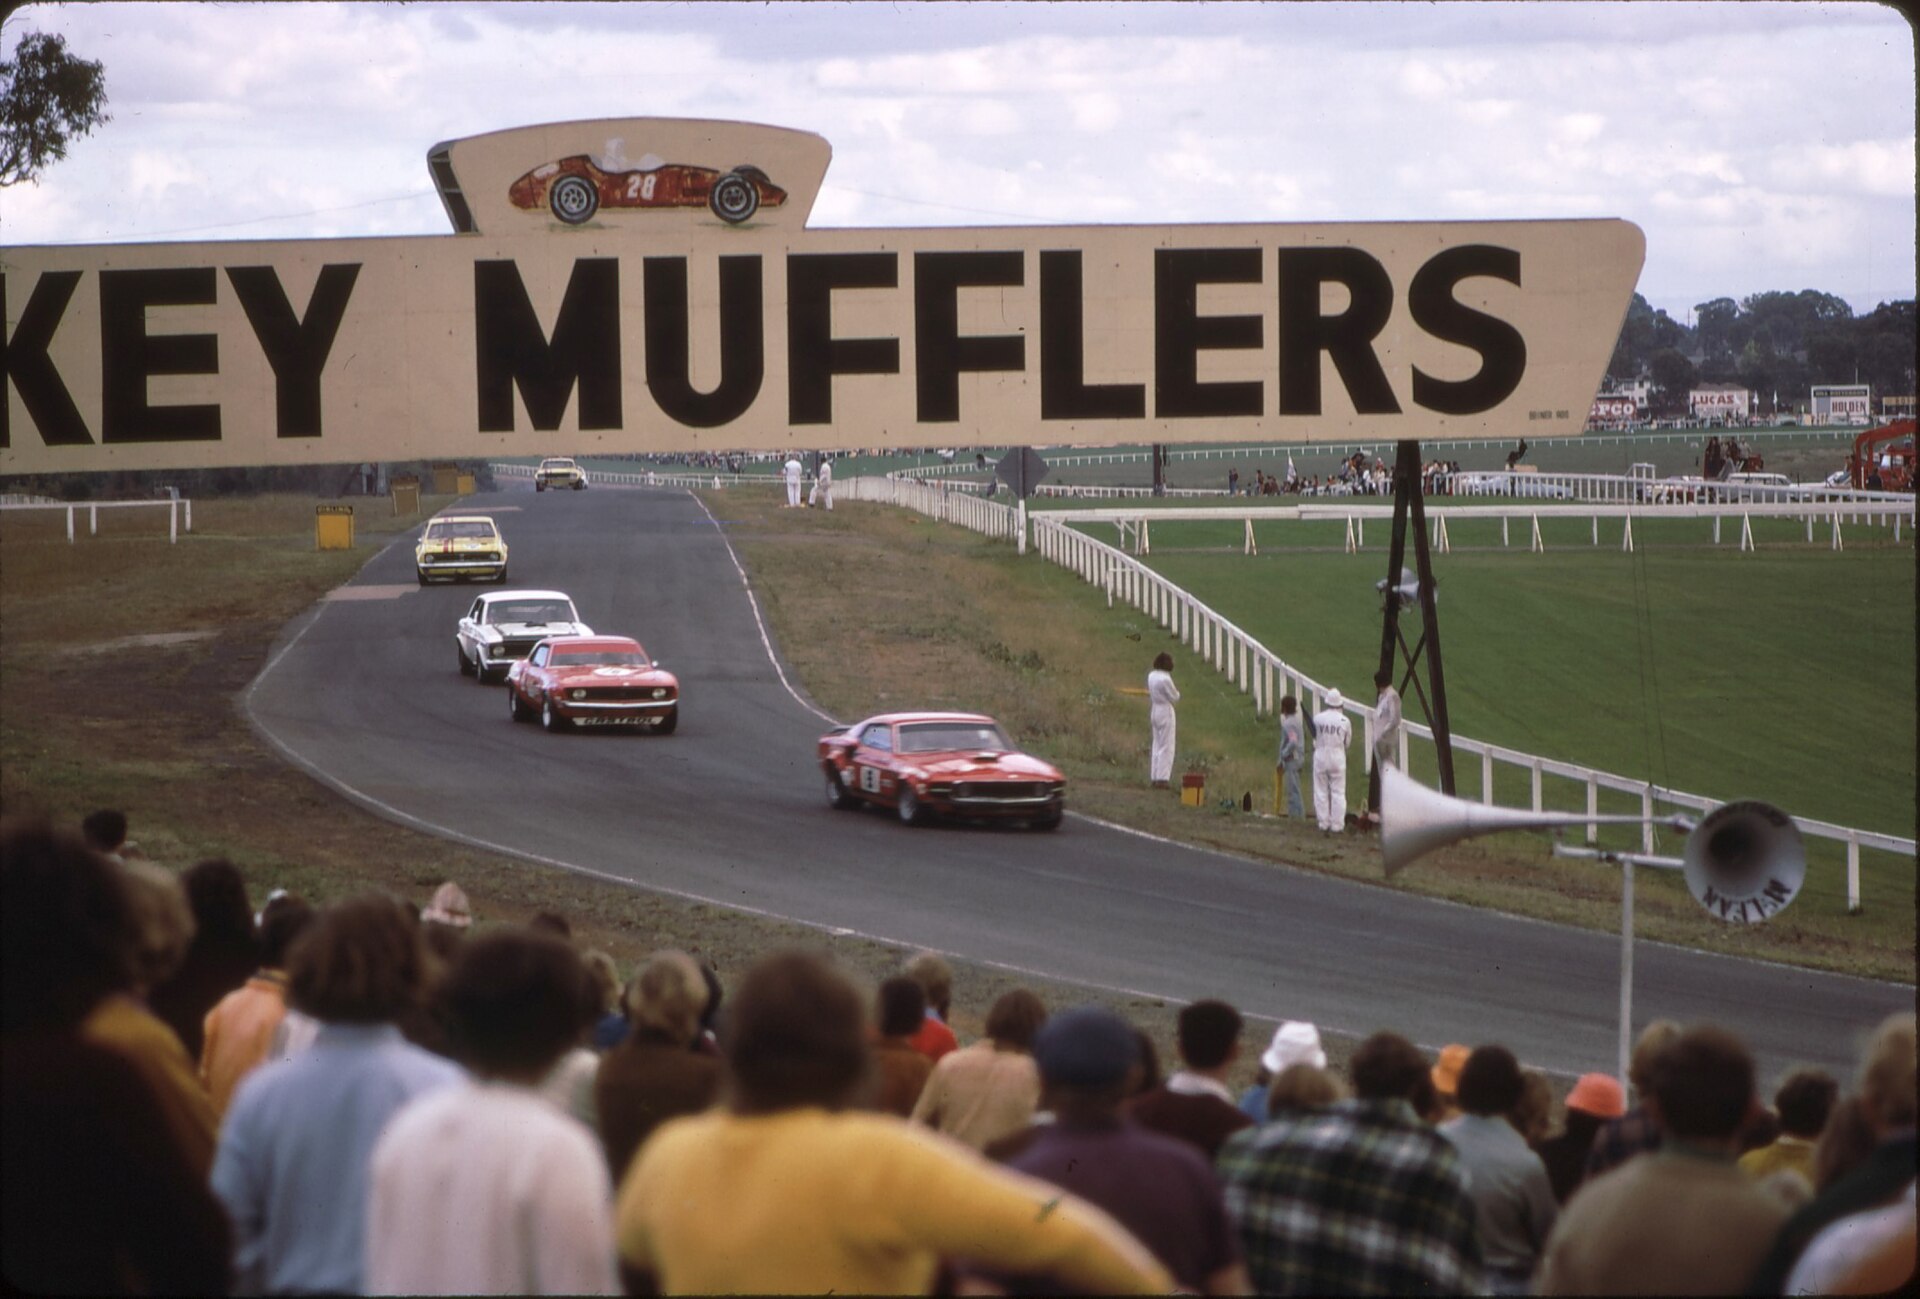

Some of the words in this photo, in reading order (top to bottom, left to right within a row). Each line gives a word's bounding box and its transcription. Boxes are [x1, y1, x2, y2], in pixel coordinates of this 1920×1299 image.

[627, 174, 657, 200] 28
[0, 264, 362, 449] KEY
[475, 243, 1527, 432] MUFFLERS
[1692, 394, 1734, 405] LUCAS
[1832, 401, 1866, 413] HOLDEN
